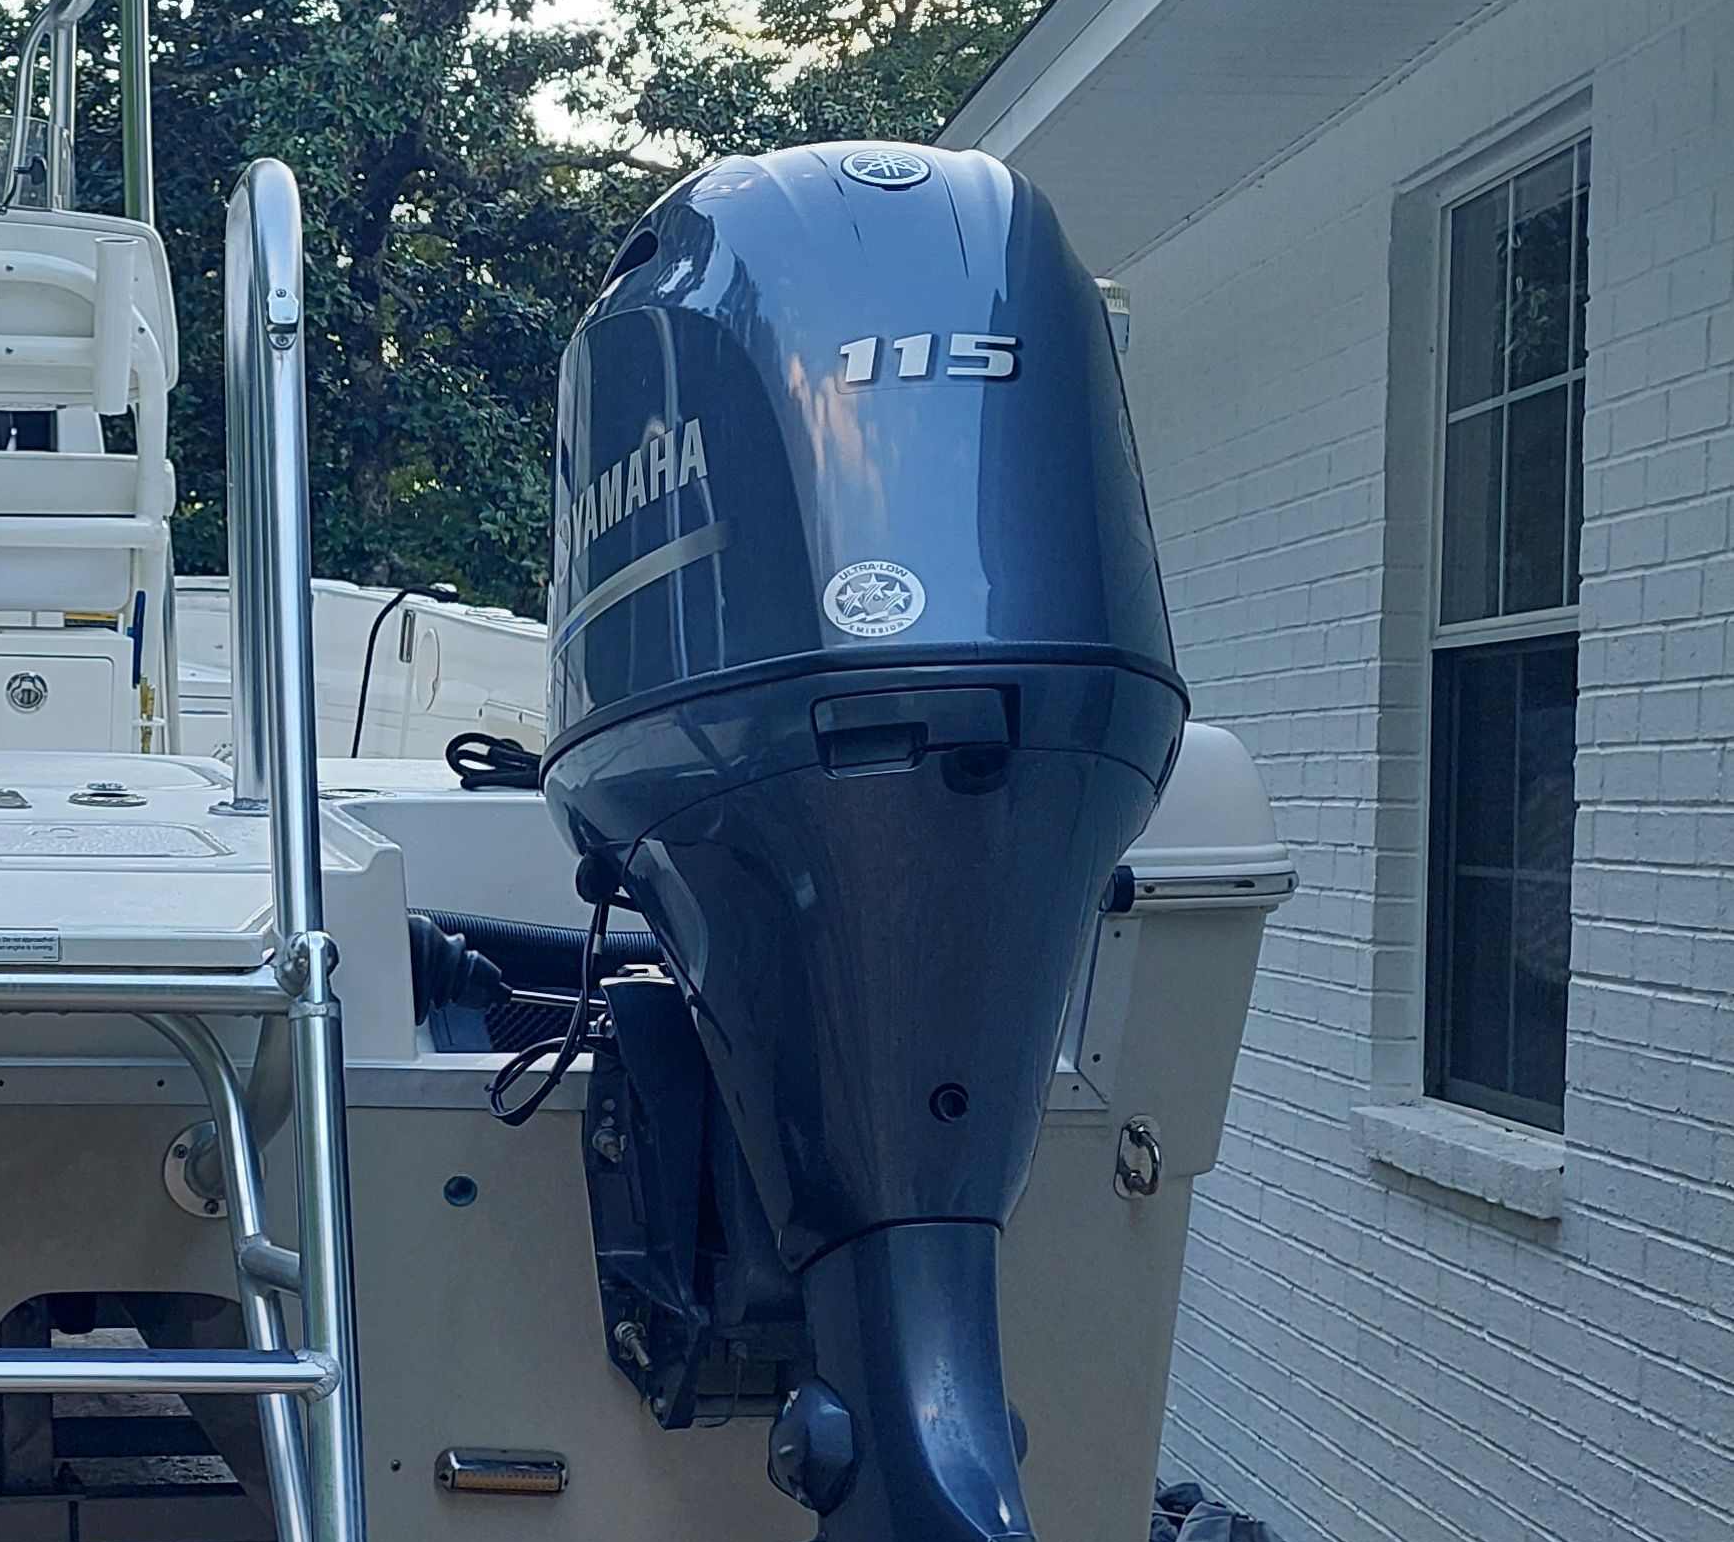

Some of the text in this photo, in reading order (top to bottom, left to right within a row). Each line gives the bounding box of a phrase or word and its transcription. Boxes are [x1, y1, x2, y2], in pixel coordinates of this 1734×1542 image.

[839, 333, 1018, 383] 115
[571, 418, 708, 560] YAMAHA
[849, 621, 905, 634] EMISSION
